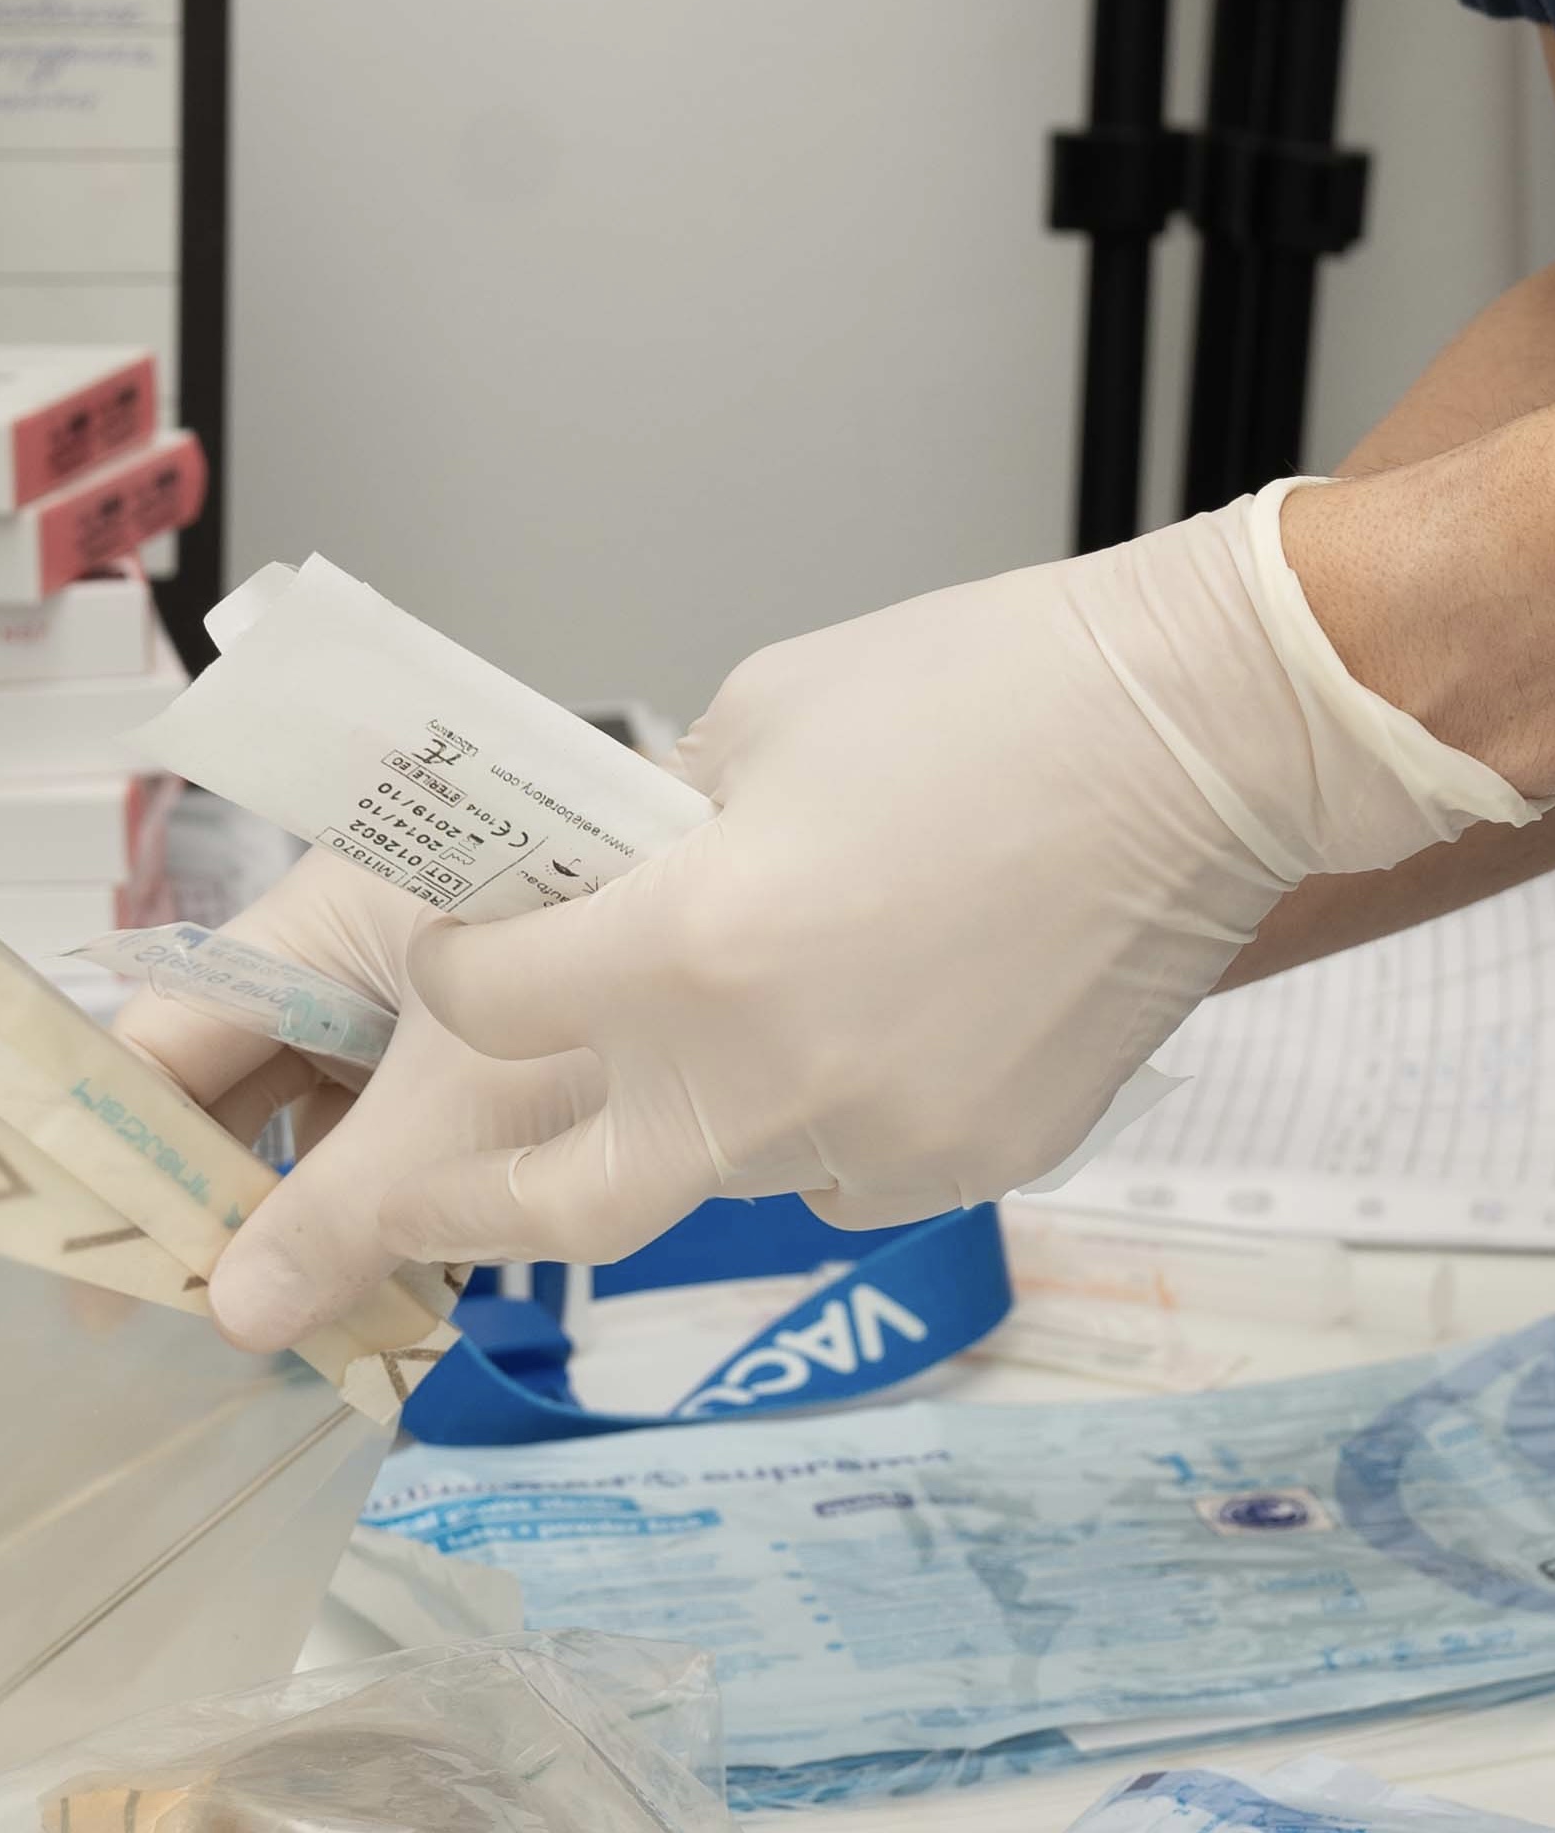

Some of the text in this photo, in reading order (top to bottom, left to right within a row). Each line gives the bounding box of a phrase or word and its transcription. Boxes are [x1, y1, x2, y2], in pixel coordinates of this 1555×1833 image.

[390, 755, 462, 806] STERILE EO
[356, 797, 444, 853] 2014/10
[376, 782, 462, 839] 2019/10
[465, 803, 497, 826] 1014
[425, 860, 464, 891] LOT
[406, 883, 448, 910] REF
